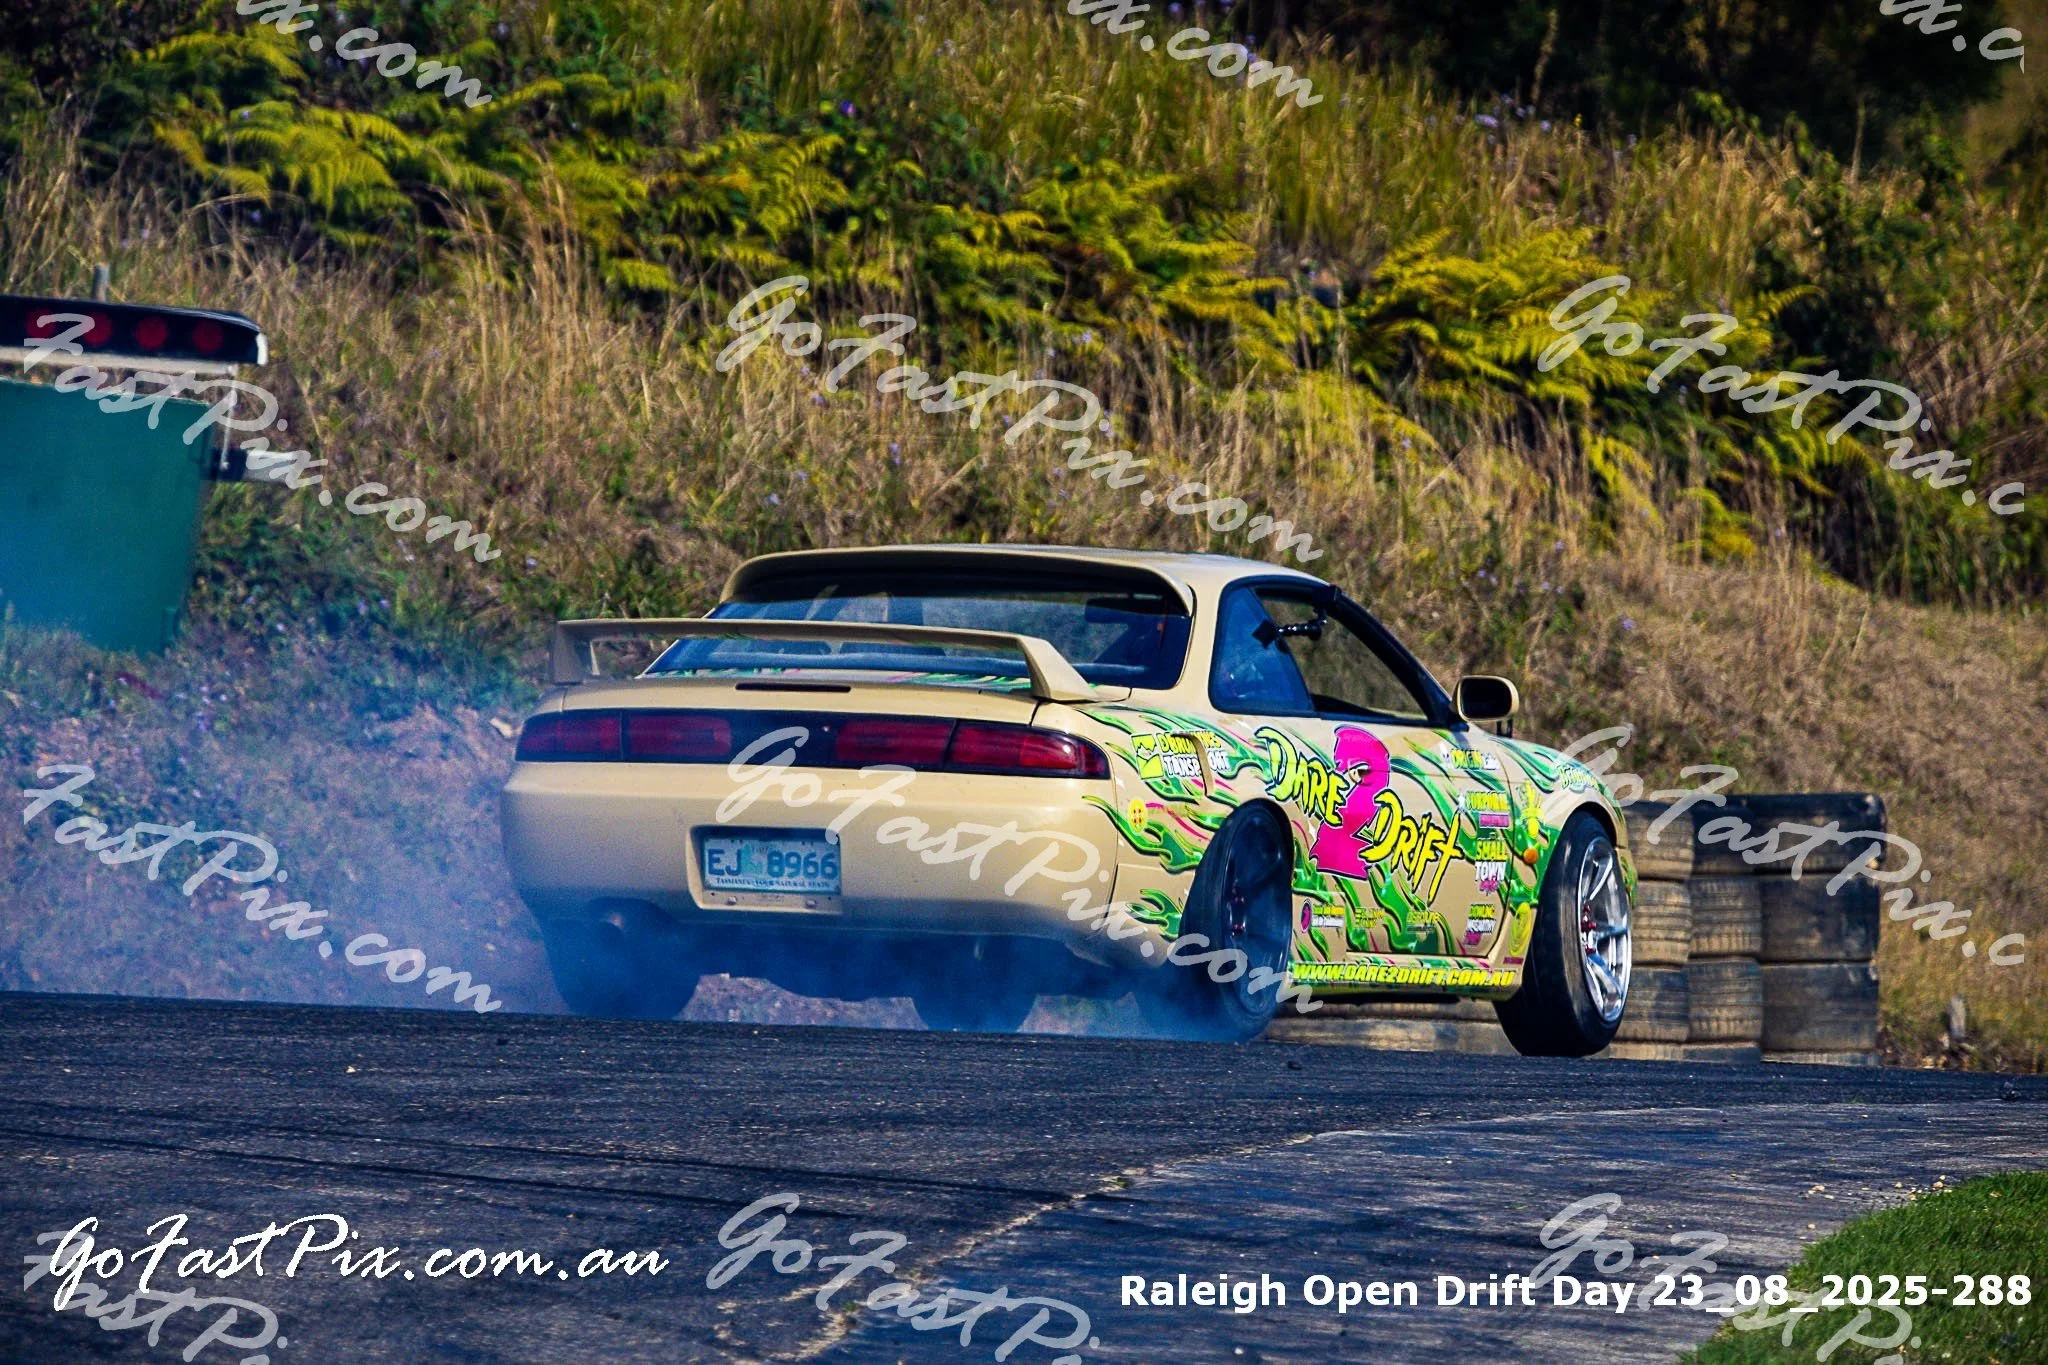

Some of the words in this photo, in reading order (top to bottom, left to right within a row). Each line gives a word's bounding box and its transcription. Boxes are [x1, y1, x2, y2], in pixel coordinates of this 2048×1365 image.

[1254, 726, 1352, 828] DARE
[1476, 840, 1508, 860] SMALL
[707, 849, 742, 876] EJ
[767, 851, 838, 880] 8966
[1475, 861, 1507, 881] TOWN
[1292, 962, 1517, 987] WWW.DARE2DRIFT.COM.AU
